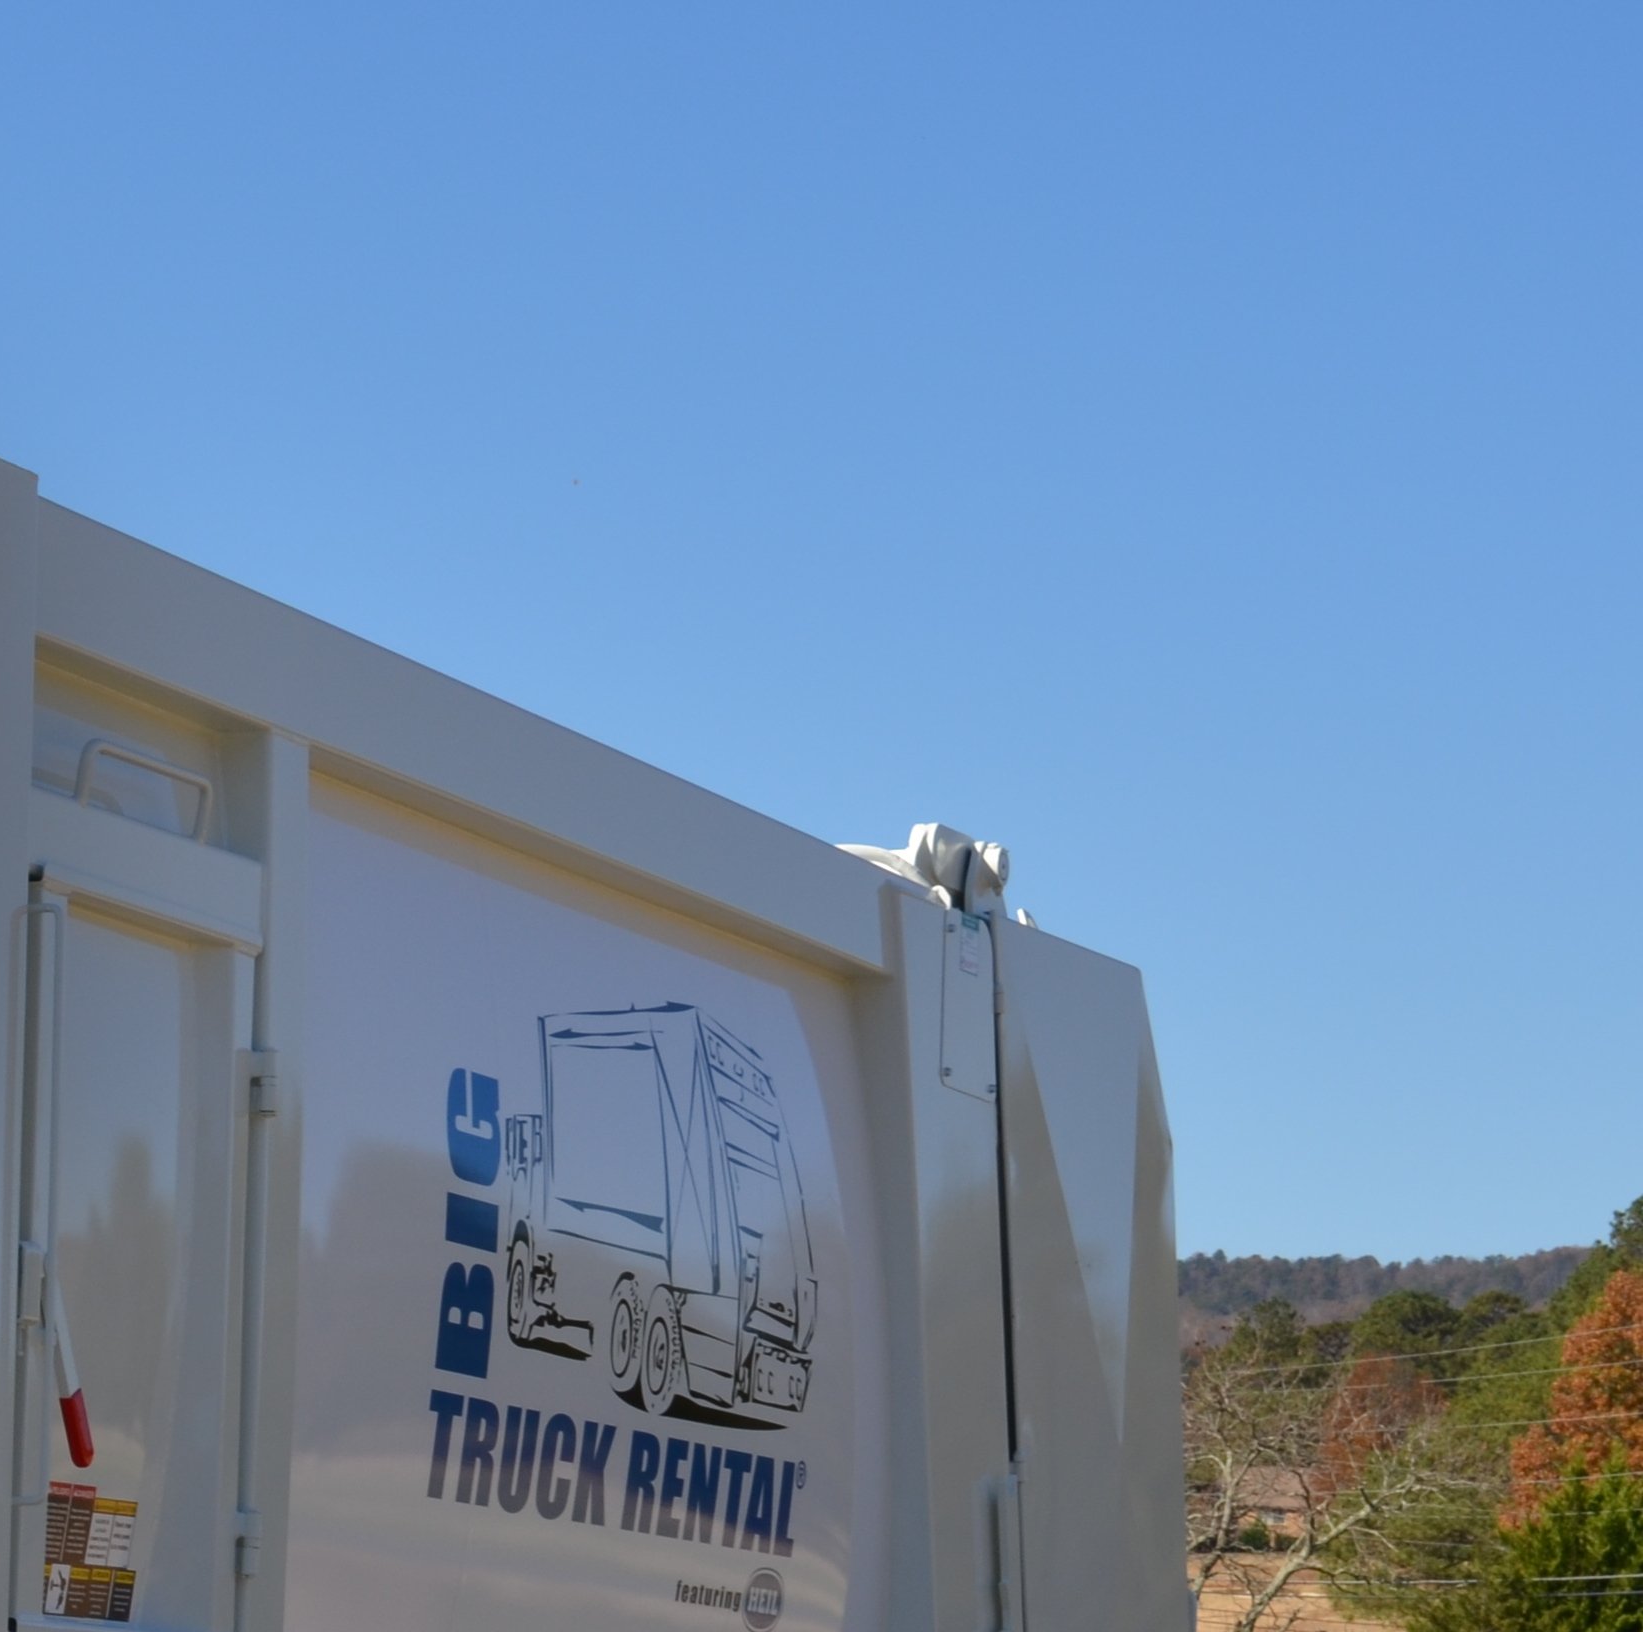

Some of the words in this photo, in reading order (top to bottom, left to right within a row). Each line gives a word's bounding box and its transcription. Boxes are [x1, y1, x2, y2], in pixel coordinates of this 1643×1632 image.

[434, 1066, 501, 1379] BIG
[426, 1388, 618, 1527] TRUCK
[674, 1578, 742, 1613] featuring
[746, 1586, 779, 1616] HEIL
